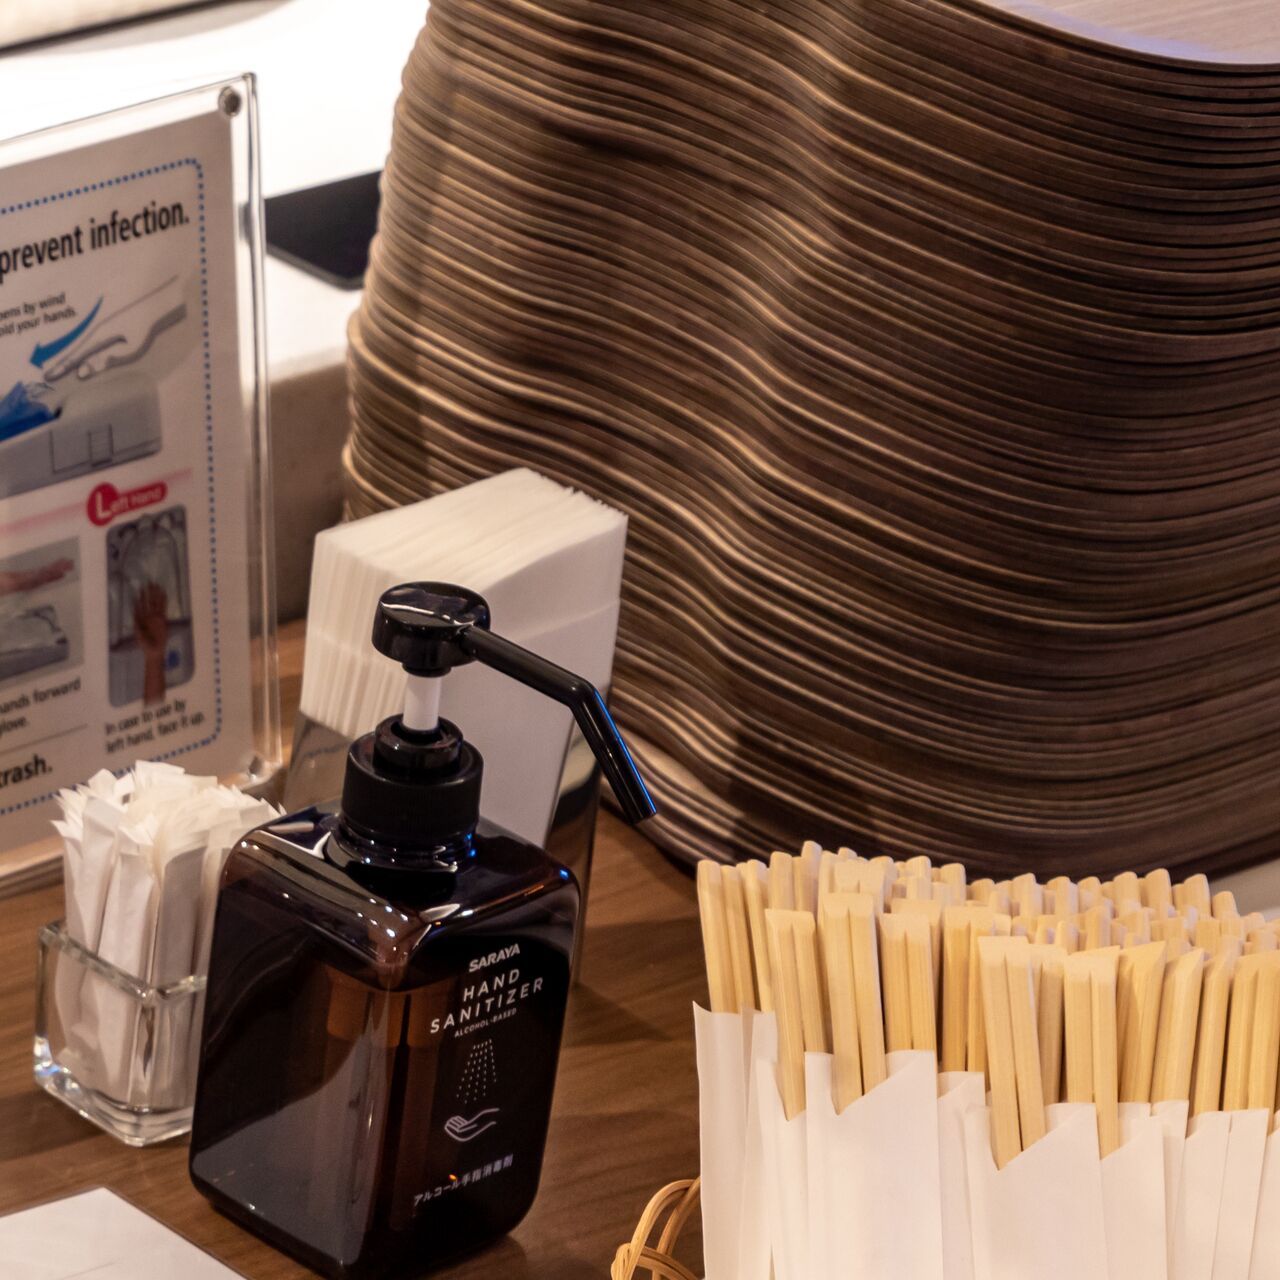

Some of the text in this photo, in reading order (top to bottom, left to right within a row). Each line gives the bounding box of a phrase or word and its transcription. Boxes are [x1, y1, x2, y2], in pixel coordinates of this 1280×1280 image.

[89, 200, 190, 250] infection.
[33, 675, 82, 703] forward
[468, 943, 521, 973] SARAYA
[463, 968, 520, 1002] HAND
[429, 977, 544, 1034] SANITIZER
